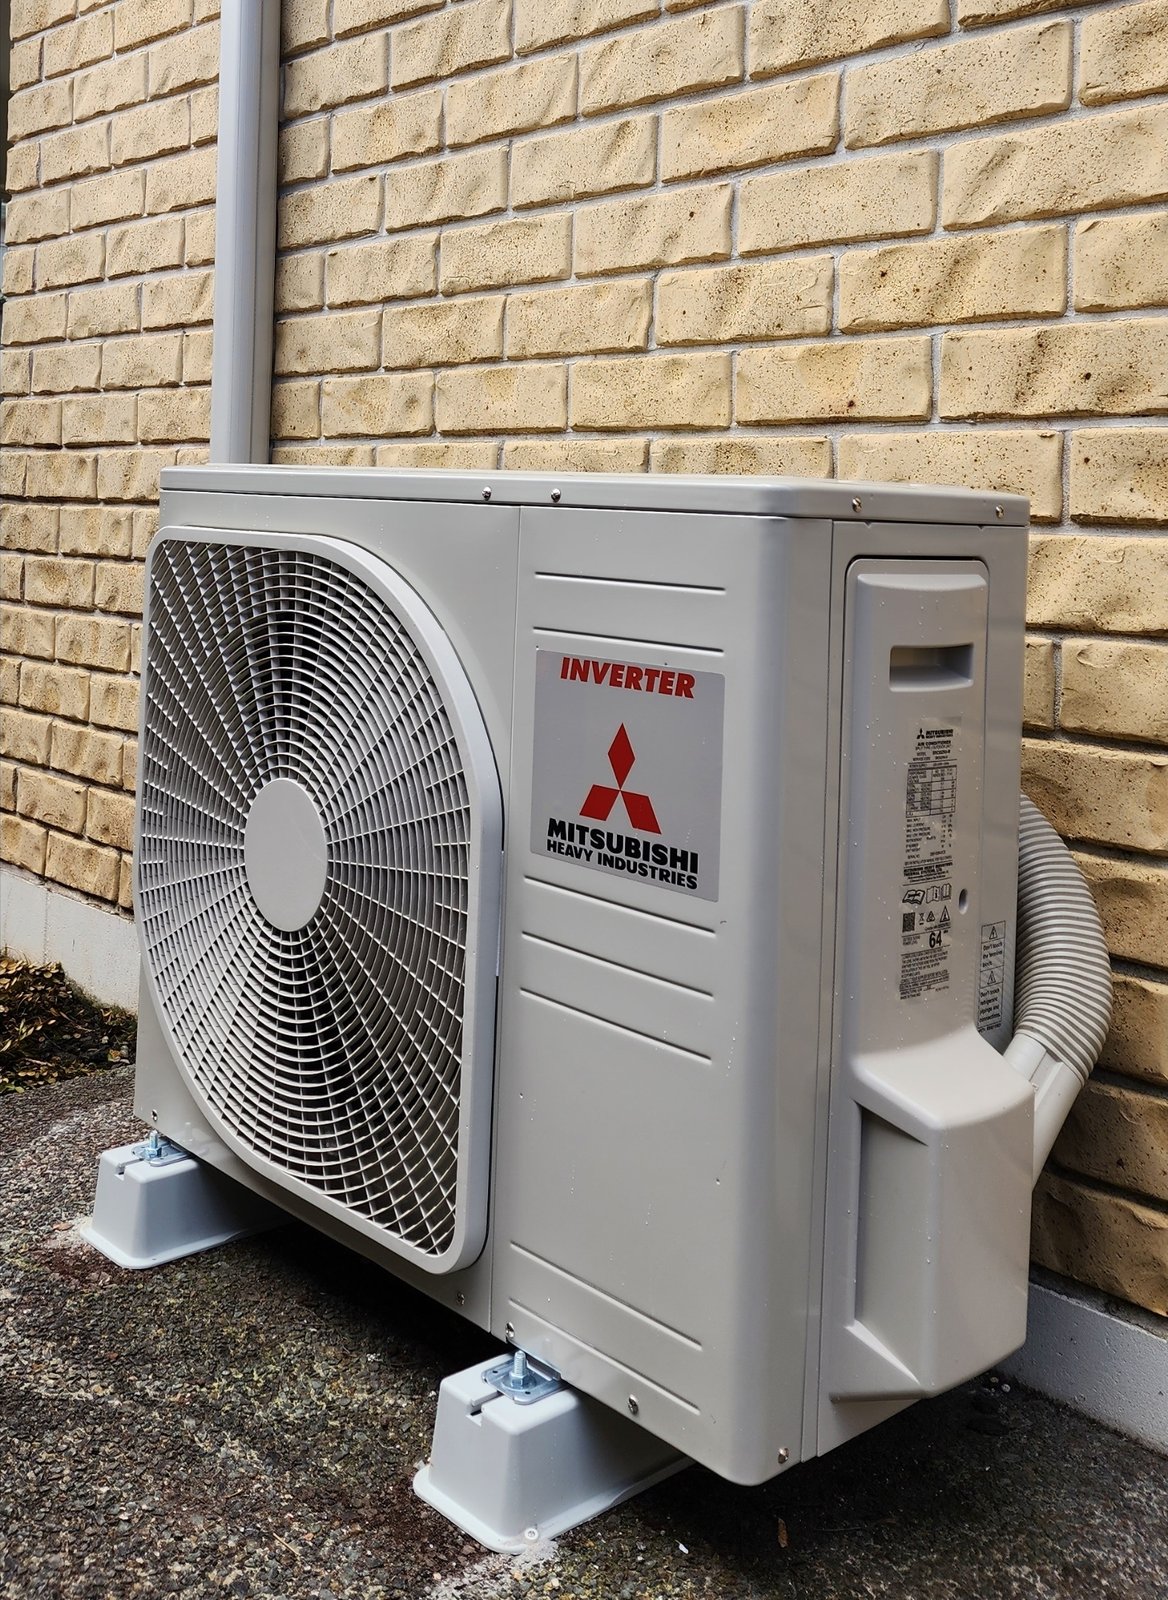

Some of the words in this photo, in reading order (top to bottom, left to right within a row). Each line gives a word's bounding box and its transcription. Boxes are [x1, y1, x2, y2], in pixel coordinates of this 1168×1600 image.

[560, 657, 696, 699] INVERTER
[547, 818, 699, 874] MITSUBISHI
[547, 839, 593, 862] HEAVY
[598, 853, 698, 890] INDUSTRIES
[929, 930, 942, 949] 64
